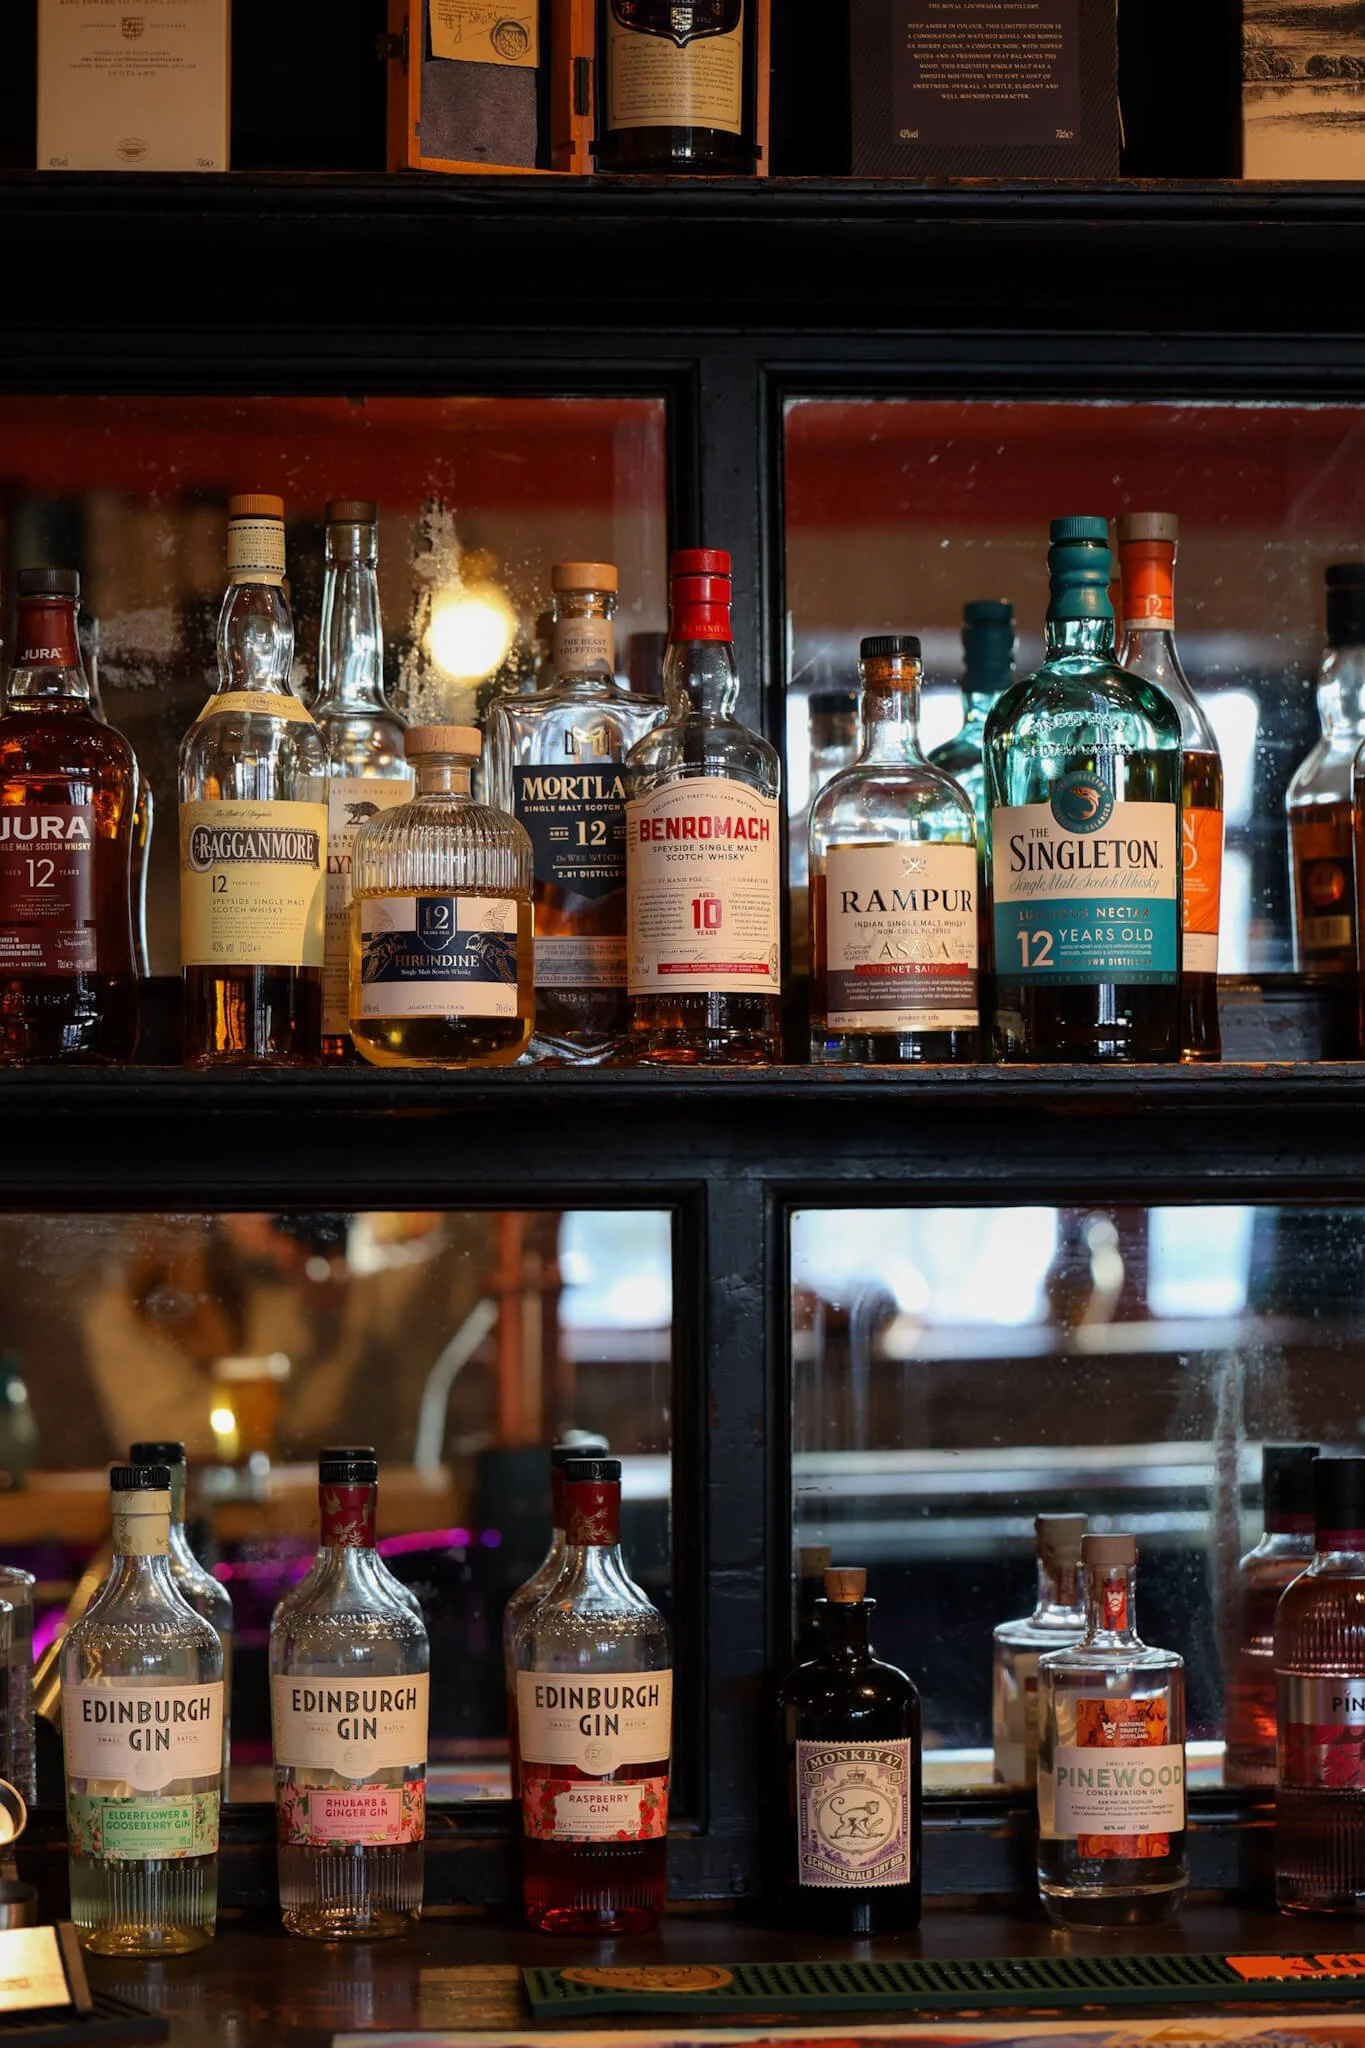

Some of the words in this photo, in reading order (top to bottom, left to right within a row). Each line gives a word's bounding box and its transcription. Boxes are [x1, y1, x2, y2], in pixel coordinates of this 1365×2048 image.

[21, 648, 62, 660] JURA
[521, 776, 627, 801] MORTLA
[524, 805, 556, 813] SINGLE
[558, 804, 582, 812] MALT
[585, 803, 621, 812] SCOTCH
[0, 816, 91, 841] JURA
[575, 820, 607, 846] 12
[639, 816, 770, 842] BENROMACH
[1030, 828, 1050, 838] THE
[16, 842, 33, 851] MALT
[36, 842, 62, 851] SCOTCH
[64, 842, 91, 851] WHISKY
[190, 825, 315, 872] CRAGGANMORE
[652, 845, 695, 853] SPEYSIDE
[665, 853, 704, 862] SCOTCH
[708, 853, 746, 861] WHISKY
[25, 858, 56, 888] 12
[212, 875, 228, 893] 12
[1008, 874, 1046, 896] Single
[1077, 871, 1120, 890] Scotch
[1119, 869, 1160, 893] Whisky
[212, 906, 247, 914] SCOTCH
[254, 898, 284, 906] SINGLE
[287, 899, 305, 907] MALT
[839, 888, 973, 914] RAMPUR
[423, 905, 450, 930] 12
[691, 899, 723, 930] 10
[1095, 906, 1150, 919] NECTAR
[854, 920, 884, 929] INDIAN
[887, 920, 918, 929] SINGLE
[921, 919, 941, 928] MALT
[1016, 930, 1055, 969] 12
[1058, 928, 1116, 942] YEARS
[1121, 927, 1154, 942] OLD
[395, 954, 480, 968] HIRUNDINE
[401, 968, 418, 977] Single
[419, 968, 430, 976] Malt
[431, 968, 450, 976] Scotch
[451, 968, 471, 977] Whisky
[291, 1687, 417, 1713] EDINBURGH
[535, 1684, 659, 1710] EDINBURGH
[1332, 1696, 1365, 1713] PIN
[83, 1697, 211, 1724] EDINBURGH
[337, 1717, 377, 1740] GIN
[579, 1714, 620, 1737] GIN
[130, 1728, 171, 1752] GIN
[809, 1750, 884, 1769] MONKEY
[885, 1754, 901, 1768] 47
[1056, 1765, 1183, 1789] PINEWOOD
[568, 1794, 630, 1804] RASPBERRY
[1086, 1789, 1147, 1797] CONSERVATION
[1150, 1788, 1163, 1796] GIN
[326, 1798, 378, 1807] RHUBARB
[589, 1804, 609, 1813] GIN
[109, 1810, 180, 1821] ELDERFLOWER
[324, 1808, 367, 1818] GINGER
[370, 1807, 388, 1816] GIN
[106, 1819, 172, 1831] GOOSEBERRY
[175, 1820, 191, 1829] GIN
[807, 1856, 872, 1882] SCHWARZWALD
